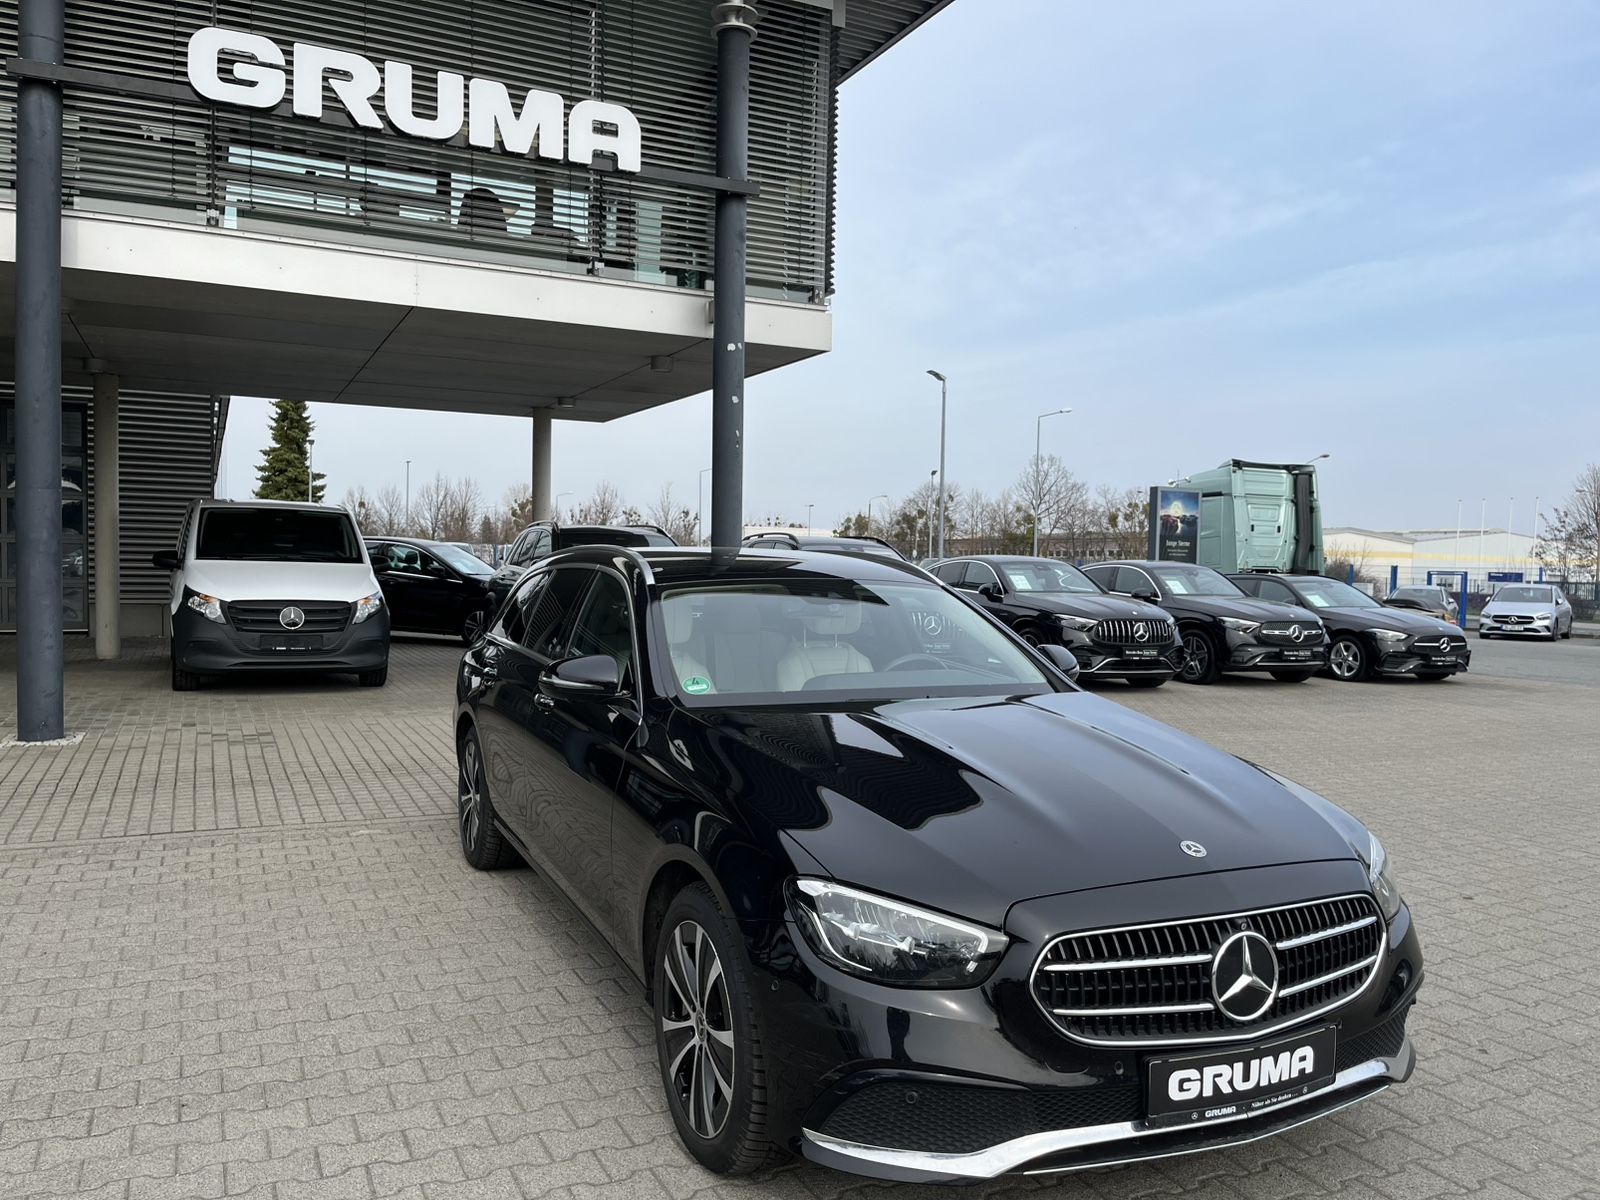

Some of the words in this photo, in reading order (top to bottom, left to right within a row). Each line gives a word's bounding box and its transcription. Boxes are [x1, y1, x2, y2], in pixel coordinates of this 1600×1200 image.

[187, 27, 642, 173] GRUMA
[692, 677, 699, 685] 4
[1168, 1045, 1314, 1101] GRUMA
[1205, 1106, 1236, 1117] GRUMA
